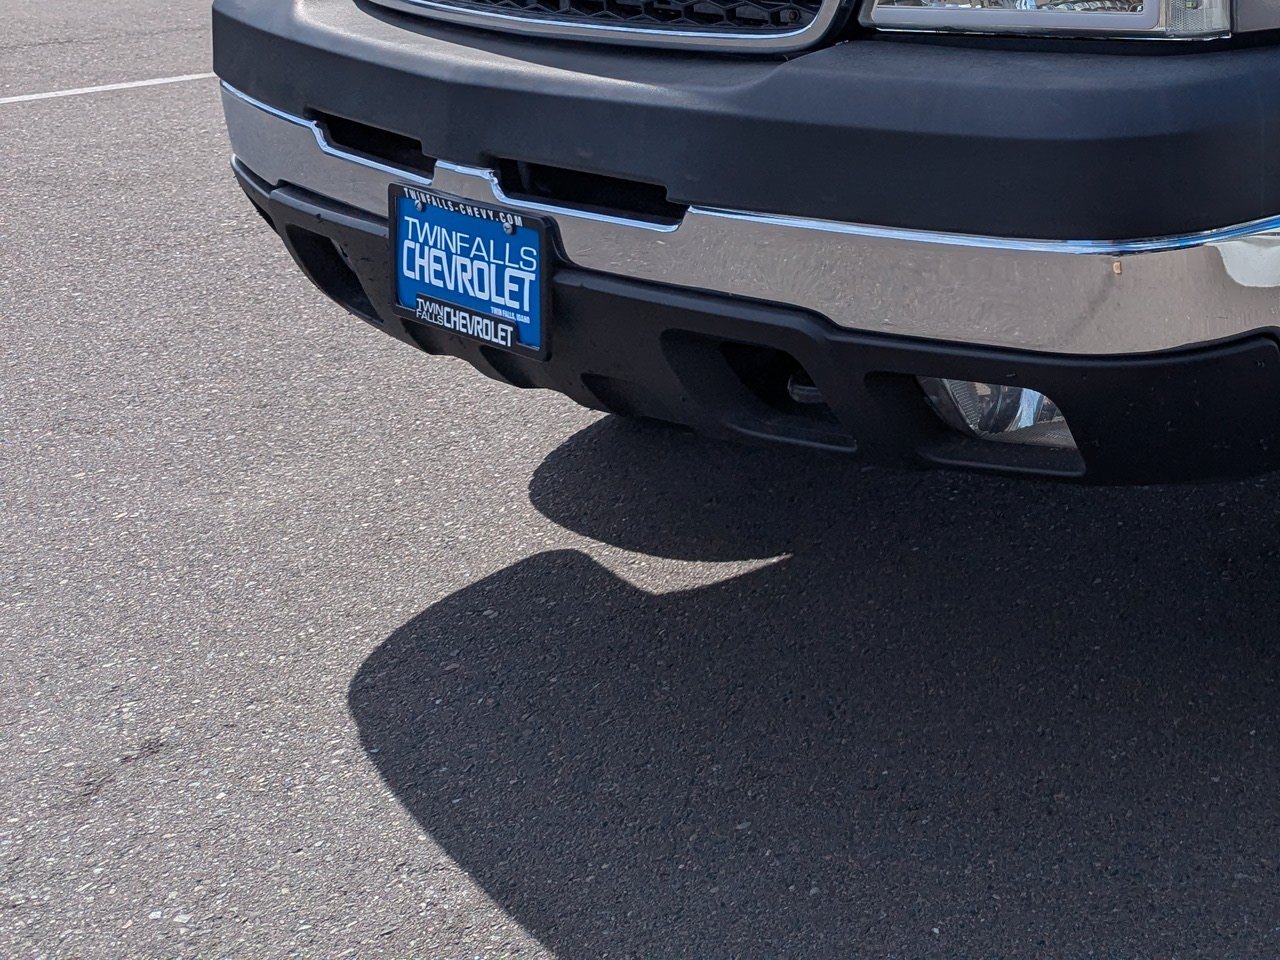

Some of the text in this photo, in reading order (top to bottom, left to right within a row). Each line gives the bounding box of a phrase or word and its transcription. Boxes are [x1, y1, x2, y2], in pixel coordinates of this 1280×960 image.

[403, 187, 523, 227] TWINFALLS-CHEVY.COM
[403, 239, 536, 312] CHEVROLET
[416, 298, 444, 317] TWIN
[416, 309, 444, 326] FALLS
[443, 306, 514, 348] CHEVROLET
